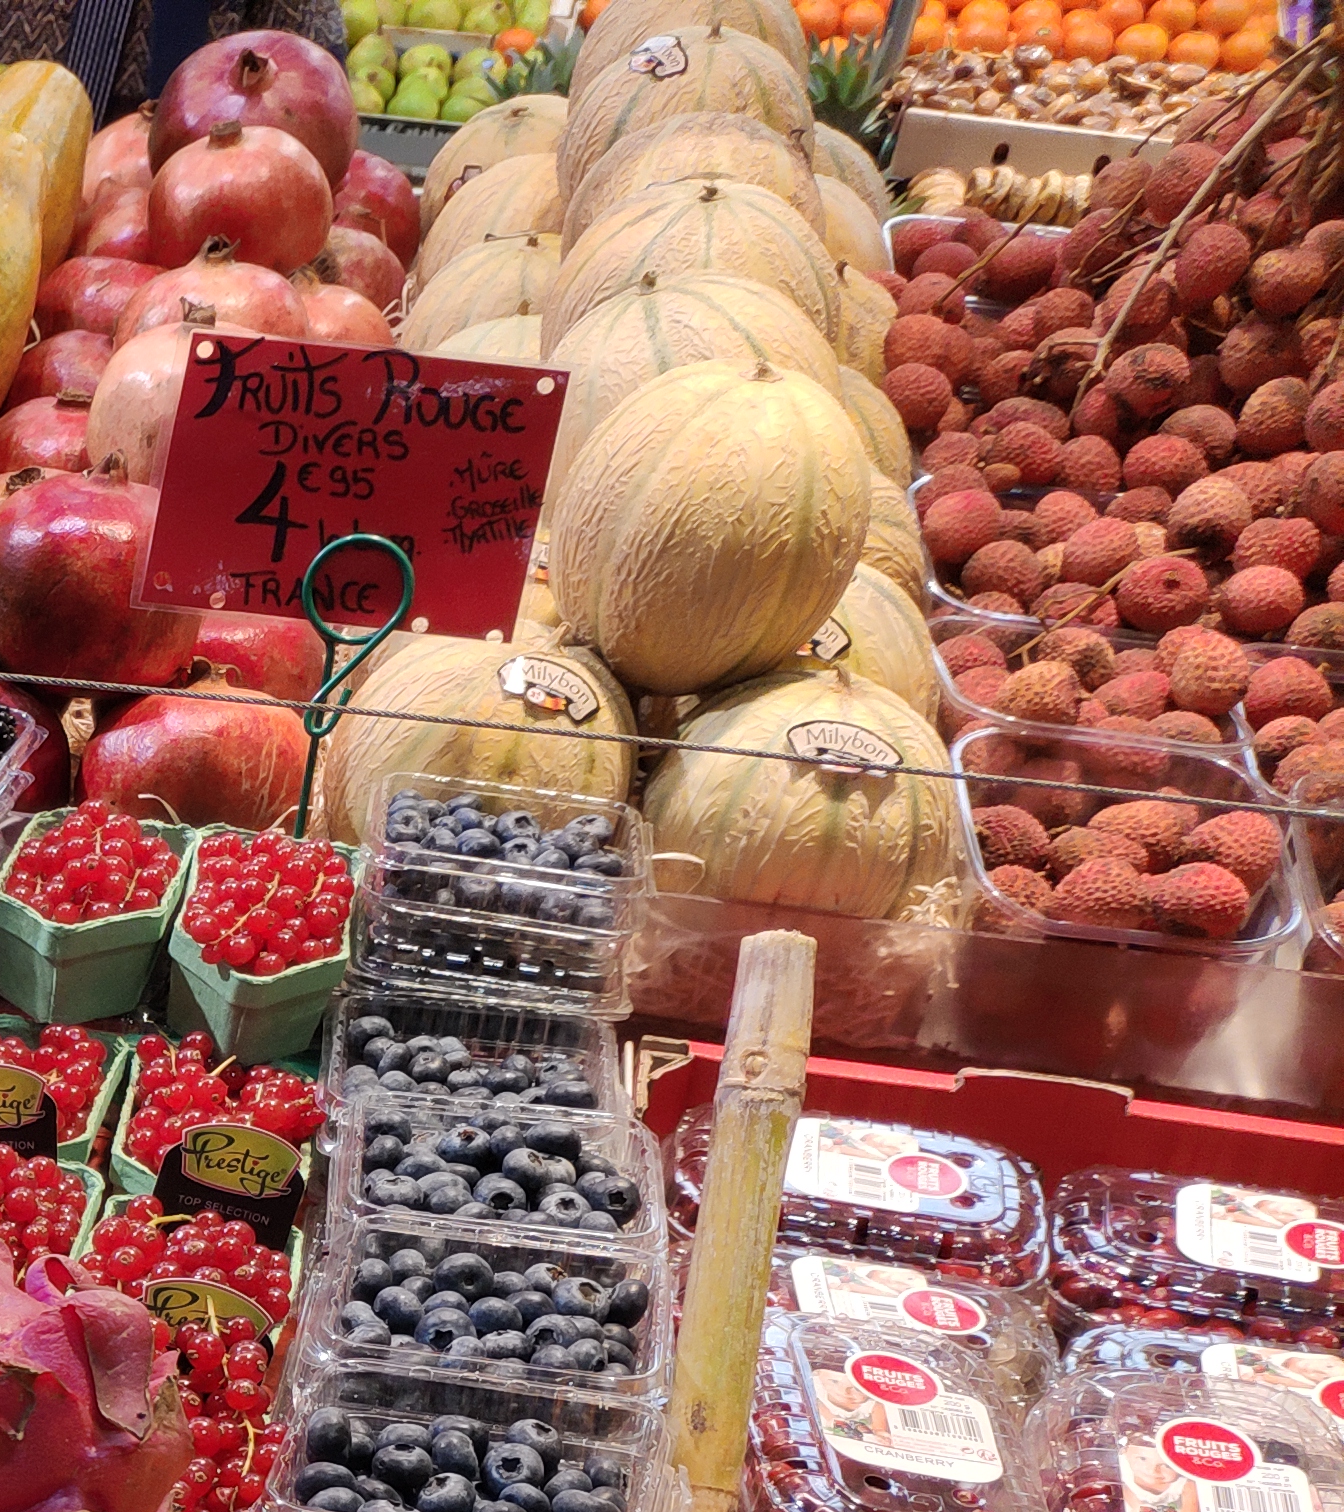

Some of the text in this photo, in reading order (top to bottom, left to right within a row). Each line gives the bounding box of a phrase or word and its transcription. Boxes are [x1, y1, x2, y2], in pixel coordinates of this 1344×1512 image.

[361, 350, 527, 434] ROUGE
[230, 570, 380, 615] FRANCE
[521, 663, 591, 707] Milybon
[806, 727, 889, 761] Milybon
[181, 1130, 291, 1198] Prestige
[178, 1194, 270, 1227] TOP SELECTION
[941, 1297, 961, 1328] FRUITS
[862, 1365, 925, 1383] FRUITS
[863, 1373, 926, 1390] ROUGES
[864, 1445, 955, 1468] CRANBERRY
[1173, 1435, 1241, 1453] FRUITS
[1174, 1445, 1243, 1462] ROUGES
